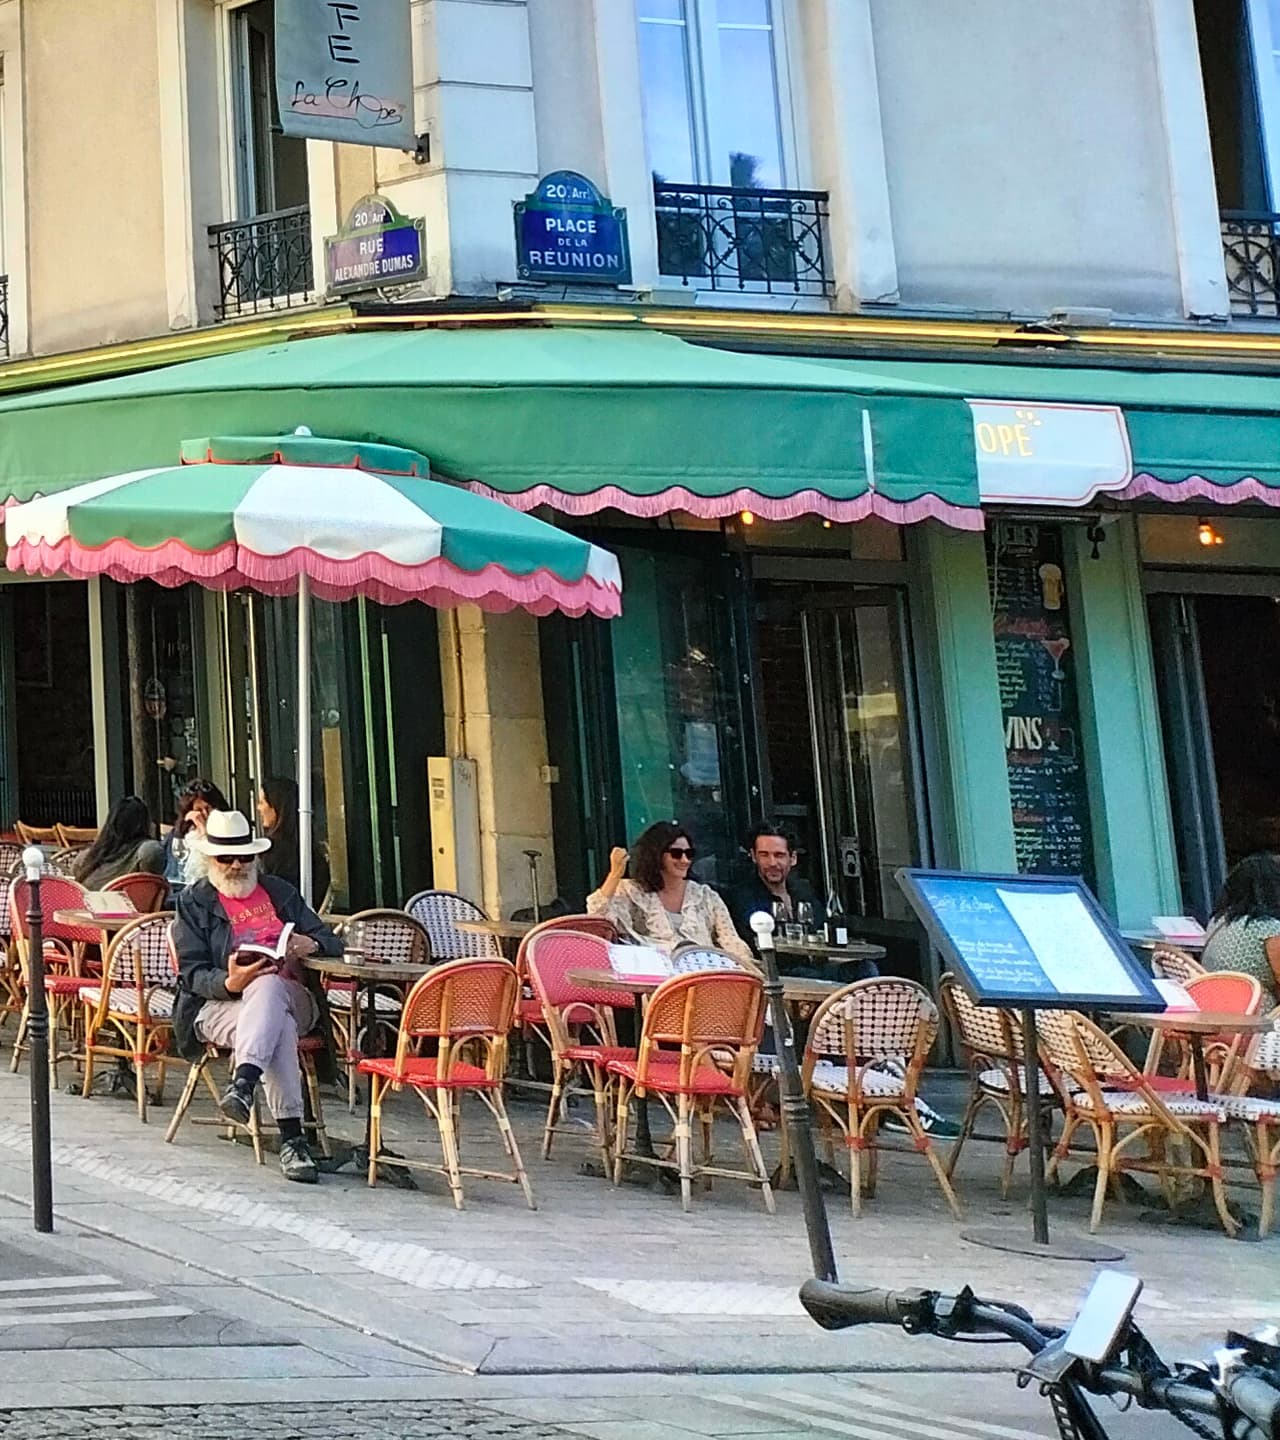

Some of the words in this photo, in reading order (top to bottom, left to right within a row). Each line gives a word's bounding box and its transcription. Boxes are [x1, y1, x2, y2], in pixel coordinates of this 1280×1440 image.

[291, 80, 320, 107] La
[325, 76, 399, 123] Chope
[545, 217, 597, 233] PLACE
[359, 237, 384, 255] RUE
[557, 238, 571, 246] DE
[575, 239, 588, 247] LA
[334, 260, 380, 282] ALEXANDRE
[382, 254, 414, 273] DUMAS
[529, 247, 619, 269] RÉUNION
